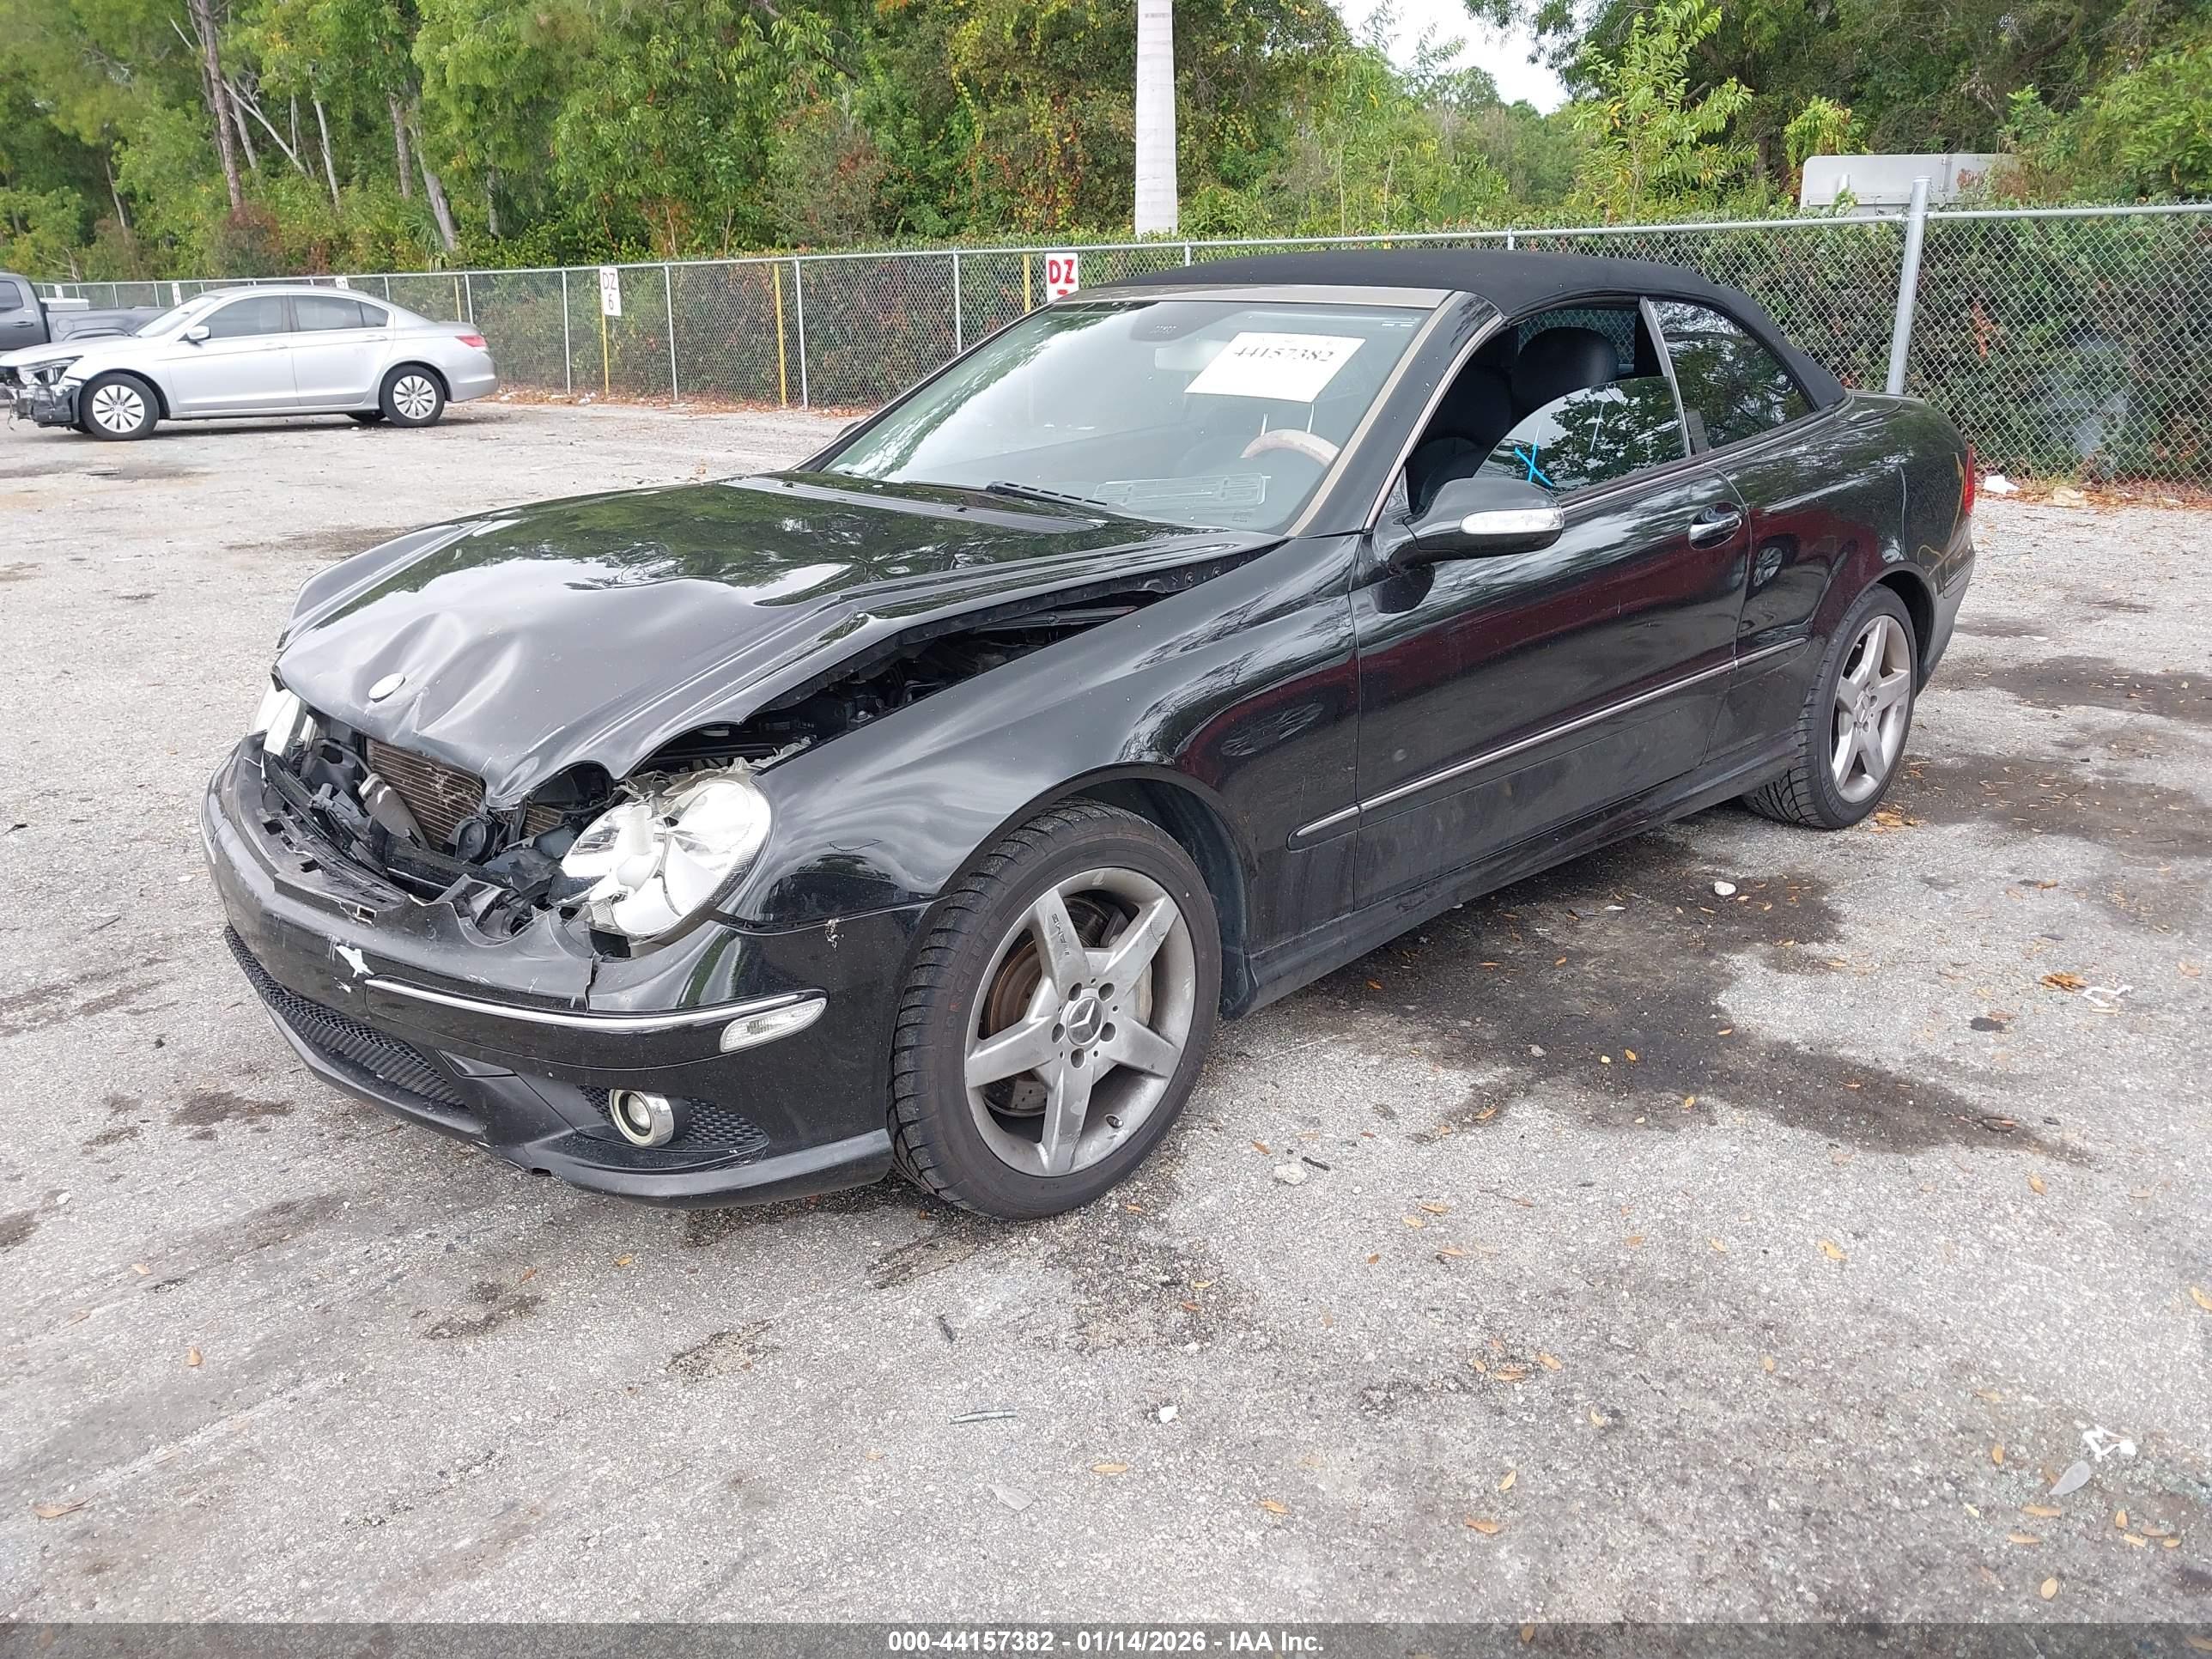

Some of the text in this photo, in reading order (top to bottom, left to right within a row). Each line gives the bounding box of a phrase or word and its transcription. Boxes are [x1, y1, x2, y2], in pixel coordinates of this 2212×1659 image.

[1048, 258, 1076, 284] DZ
[602, 272, 617, 290] DZ
[608, 293, 615, 311] 6
